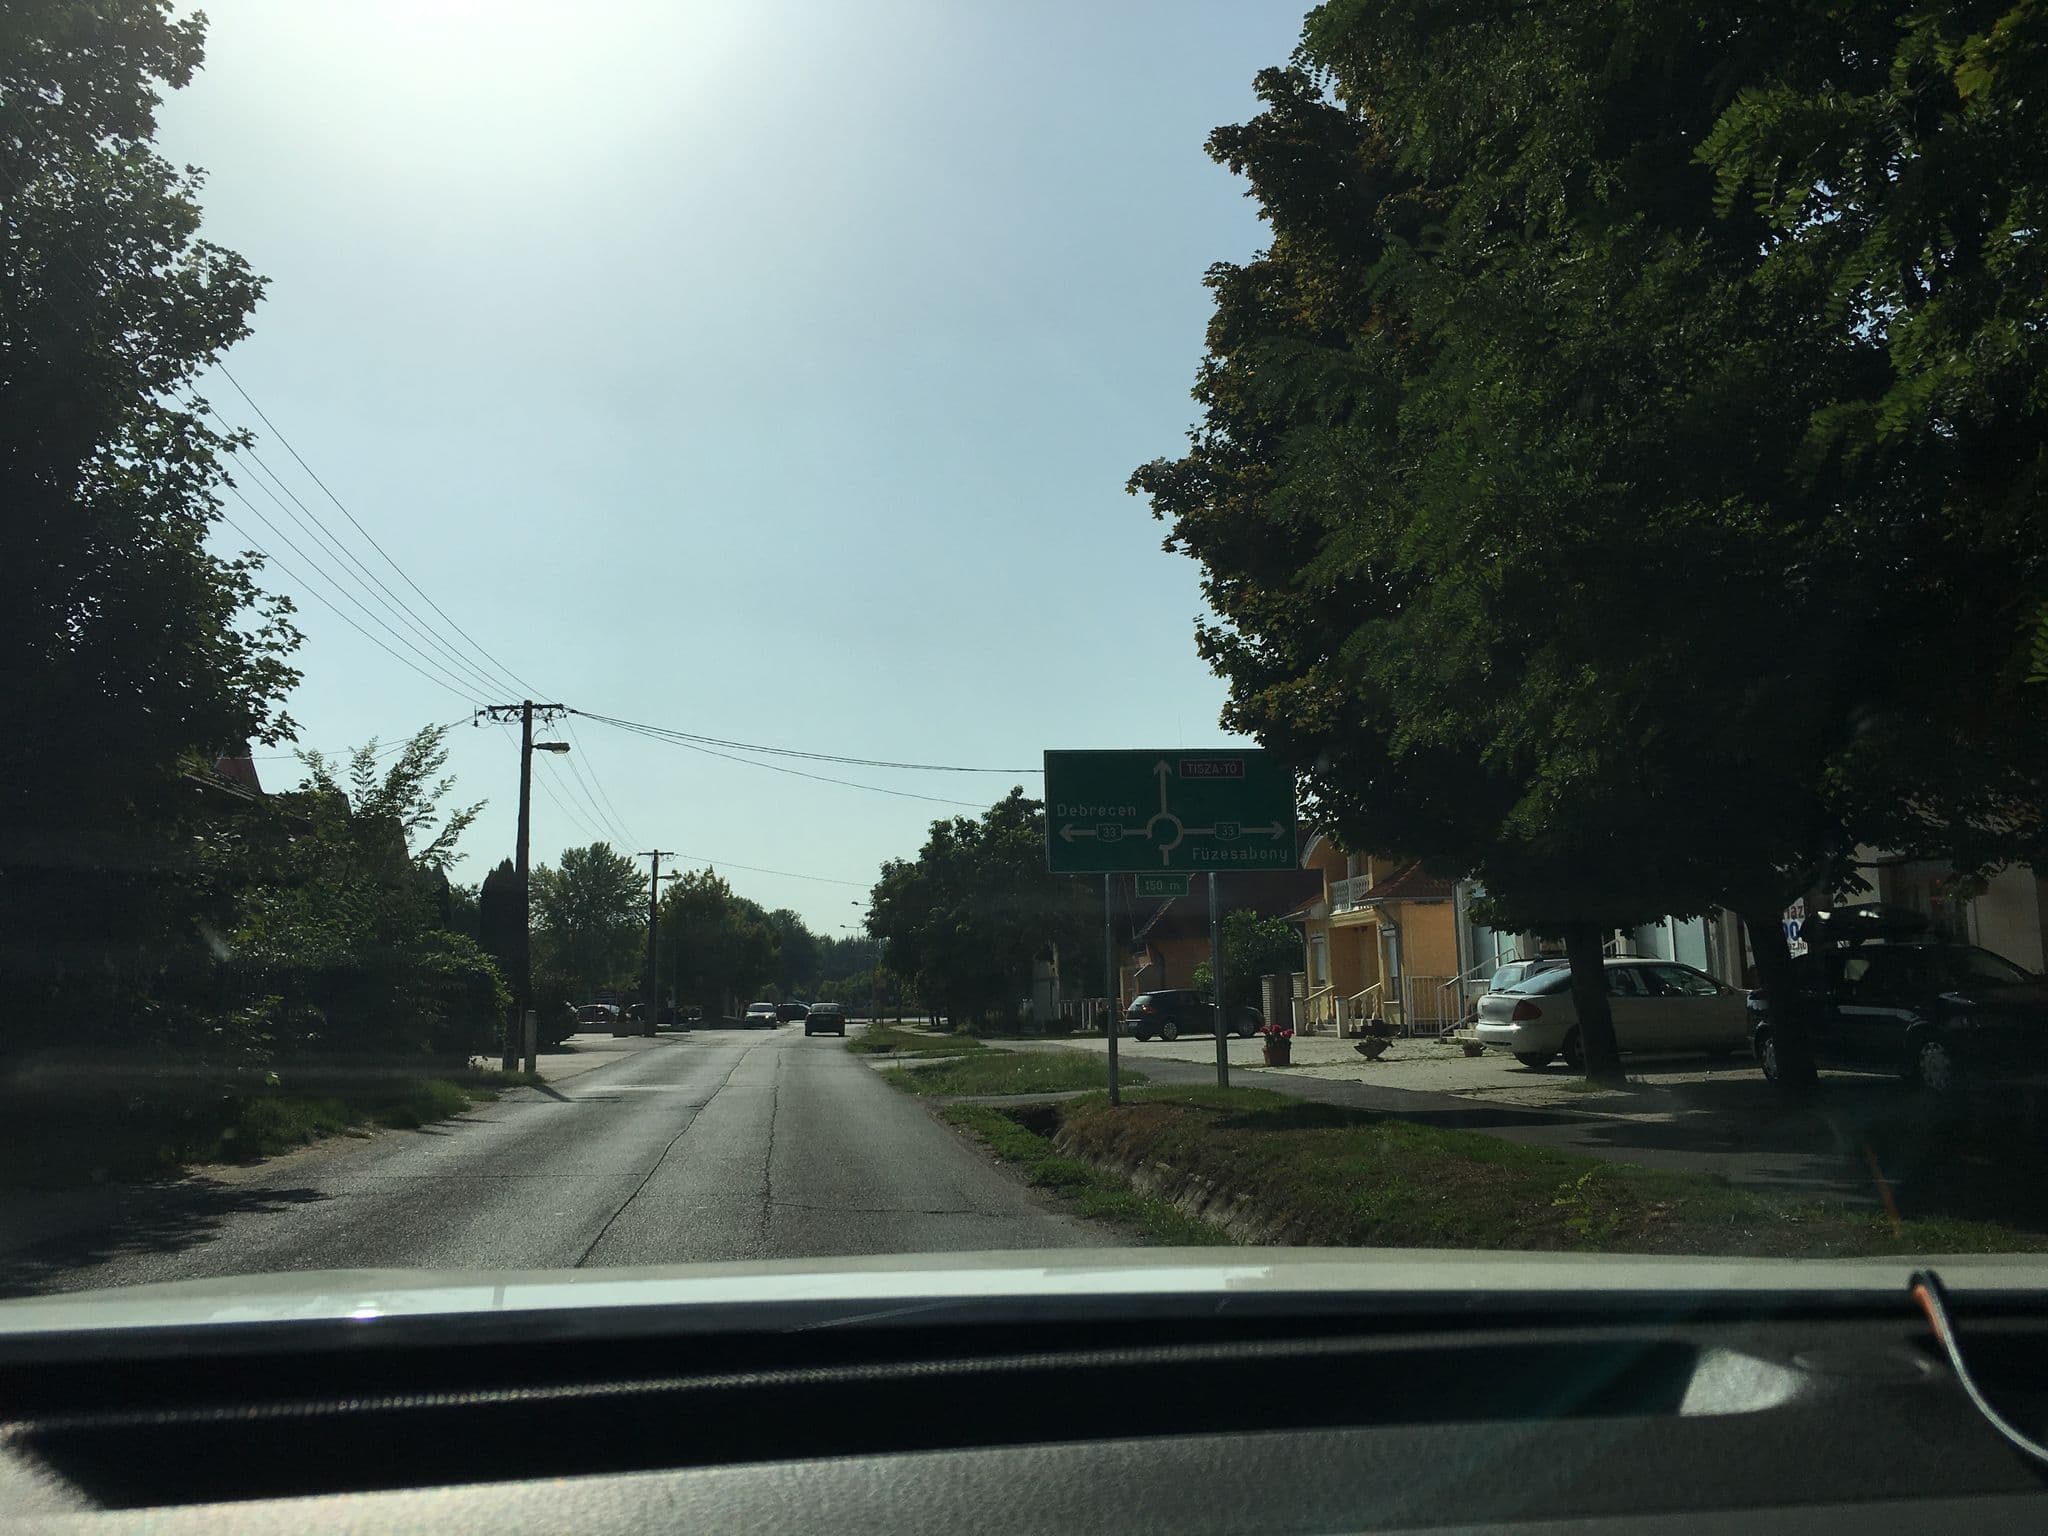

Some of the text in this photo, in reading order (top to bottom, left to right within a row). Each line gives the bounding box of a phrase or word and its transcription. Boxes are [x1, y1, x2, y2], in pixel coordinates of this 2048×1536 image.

[1057, 803, 1136, 816] Debrecen
[1222, 825, 1233, 837] 33
[1192, 846, 1288, 862] Füzesabony
[1145, 880, 1181, 890] 150 m
